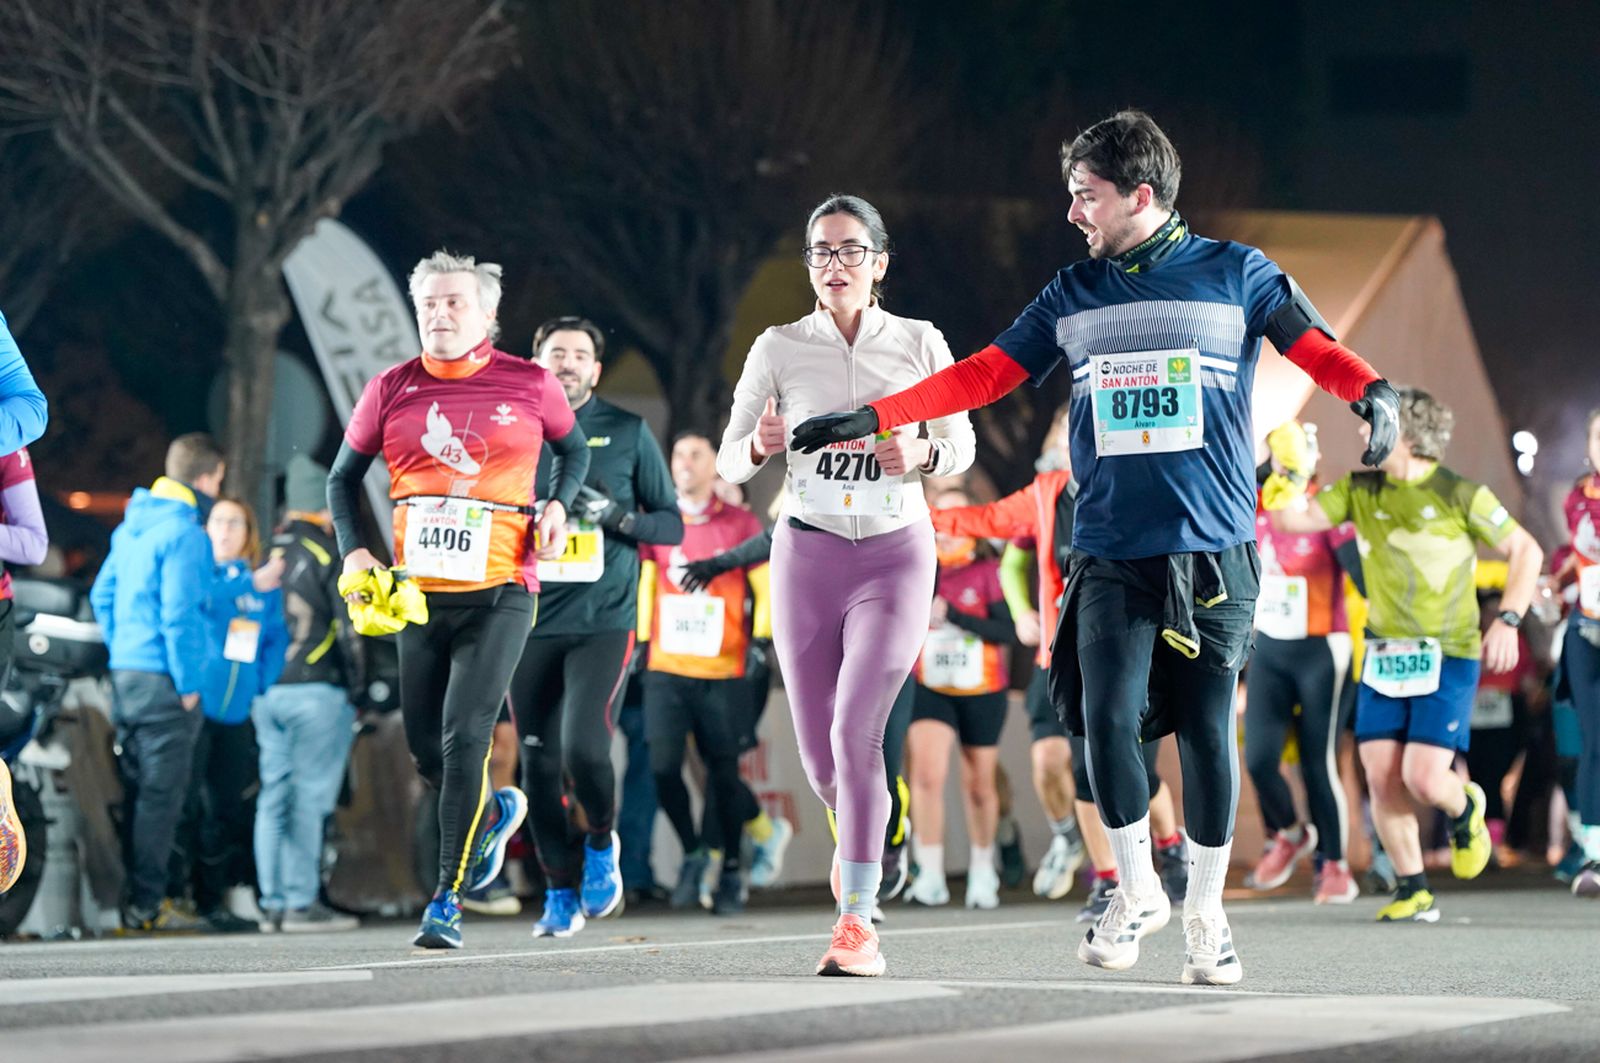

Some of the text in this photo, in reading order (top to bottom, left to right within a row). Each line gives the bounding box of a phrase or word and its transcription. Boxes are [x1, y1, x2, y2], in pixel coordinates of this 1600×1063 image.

[1112, 363, 1144, 375] NOCHE
[1145, 362, 1158, 373] DE
[1101, 378, 1121, 389] SAN
[1112, 387, 1179, 420] 8793
[440, 444, 462, 464] 43
[816, 452, 881, 482] 4270
[418, 527, 472, 552] 4406
